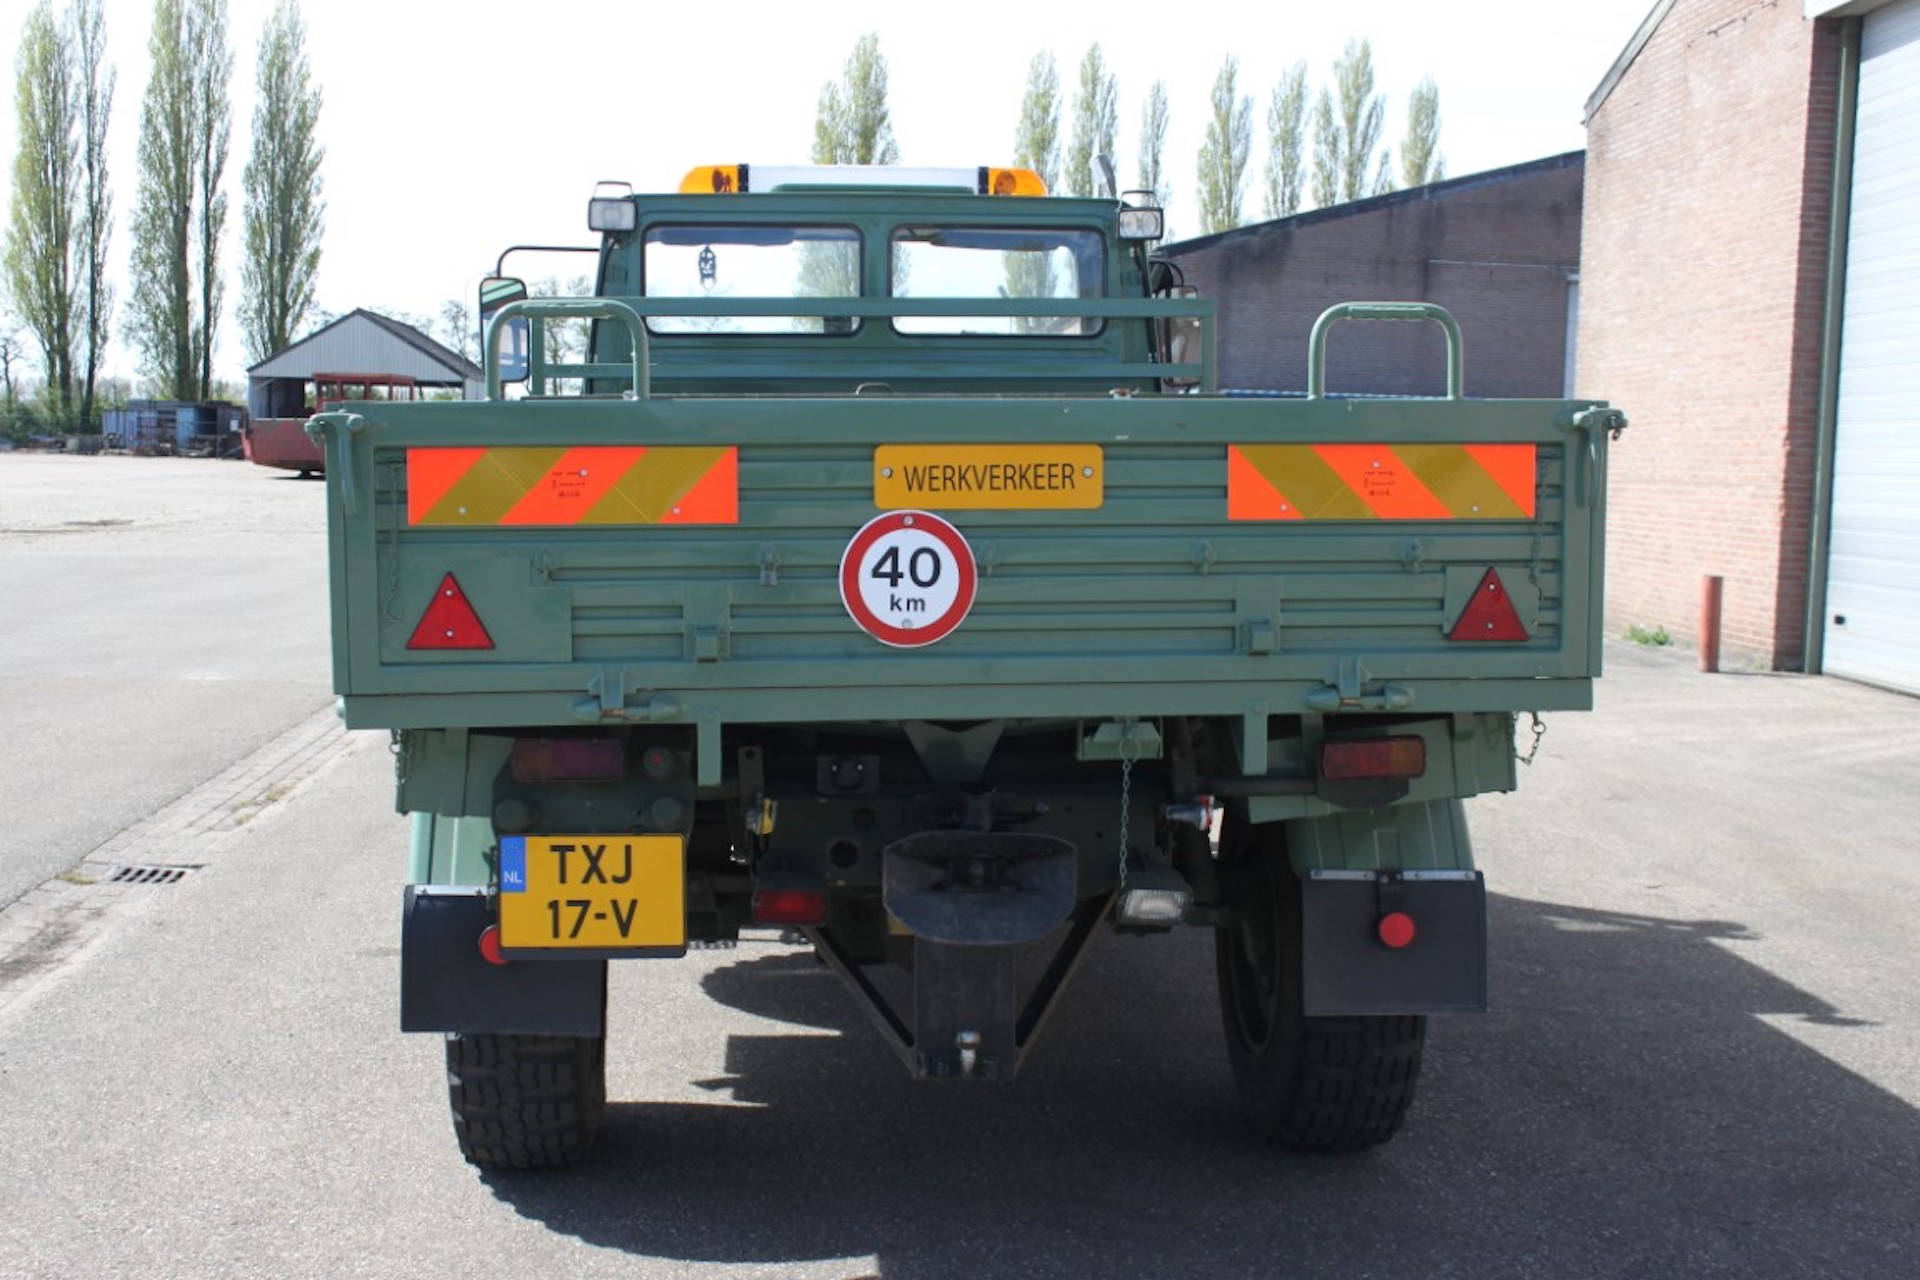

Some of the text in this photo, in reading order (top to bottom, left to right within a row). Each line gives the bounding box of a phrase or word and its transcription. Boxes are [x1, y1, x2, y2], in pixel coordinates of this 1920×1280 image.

[903, 463, 1075, 492] WERKVERKEER
[871, 546, 941, 588] 40
[890, 594, 925, 612] km
[503, 872, 522, 883] NL
[549, 844, 632, 884] TXJ
[547, 899, 638, 939] 17-V
